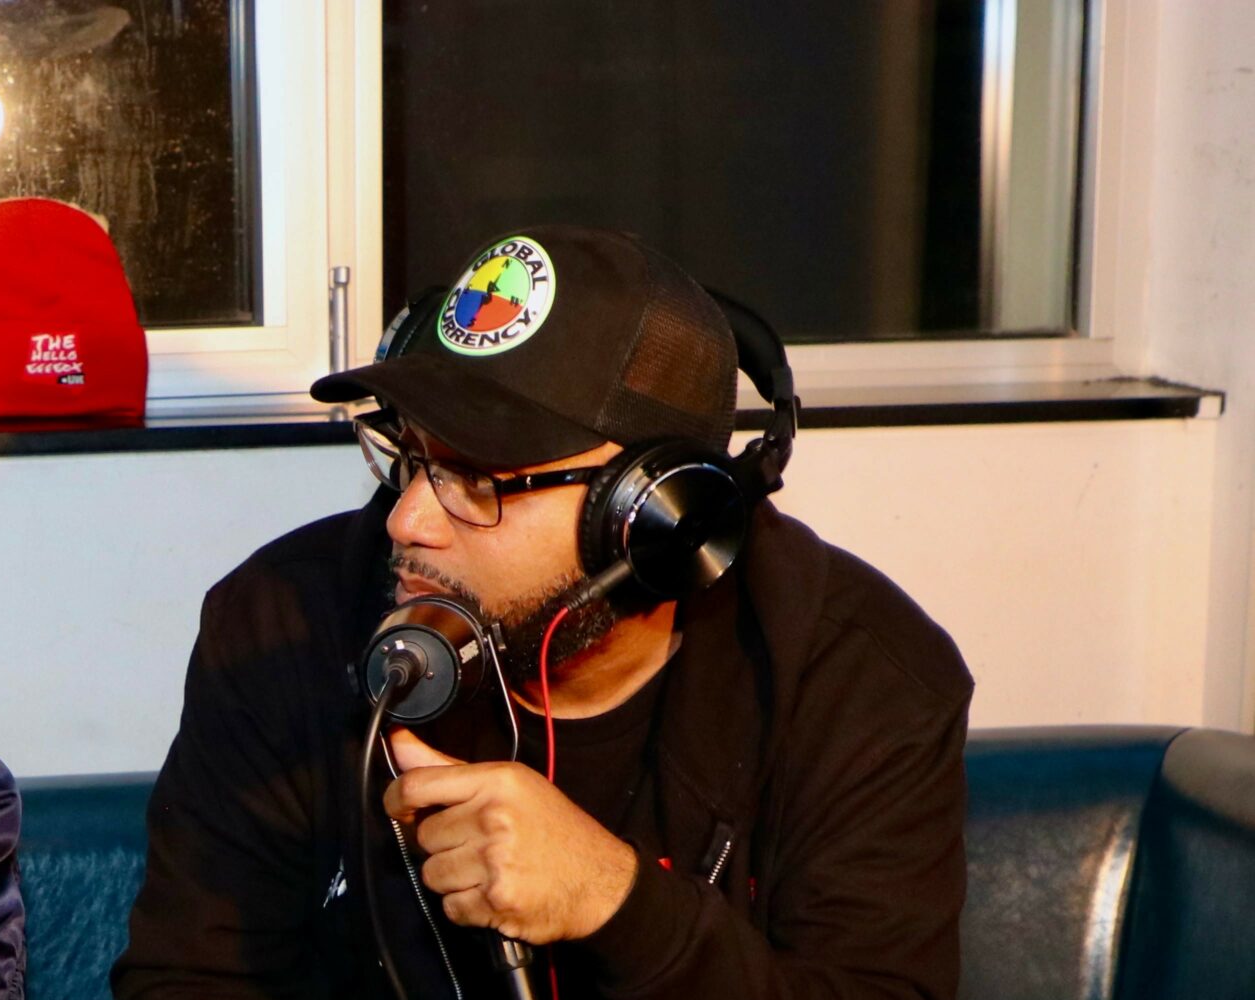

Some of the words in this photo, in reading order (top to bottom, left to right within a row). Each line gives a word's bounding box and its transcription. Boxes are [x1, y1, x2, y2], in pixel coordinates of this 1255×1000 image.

[472, 242, 548, 291] GLOBAL
[31, 333, 76, 351] THE
[31, 350, 78, 361] HELLO
